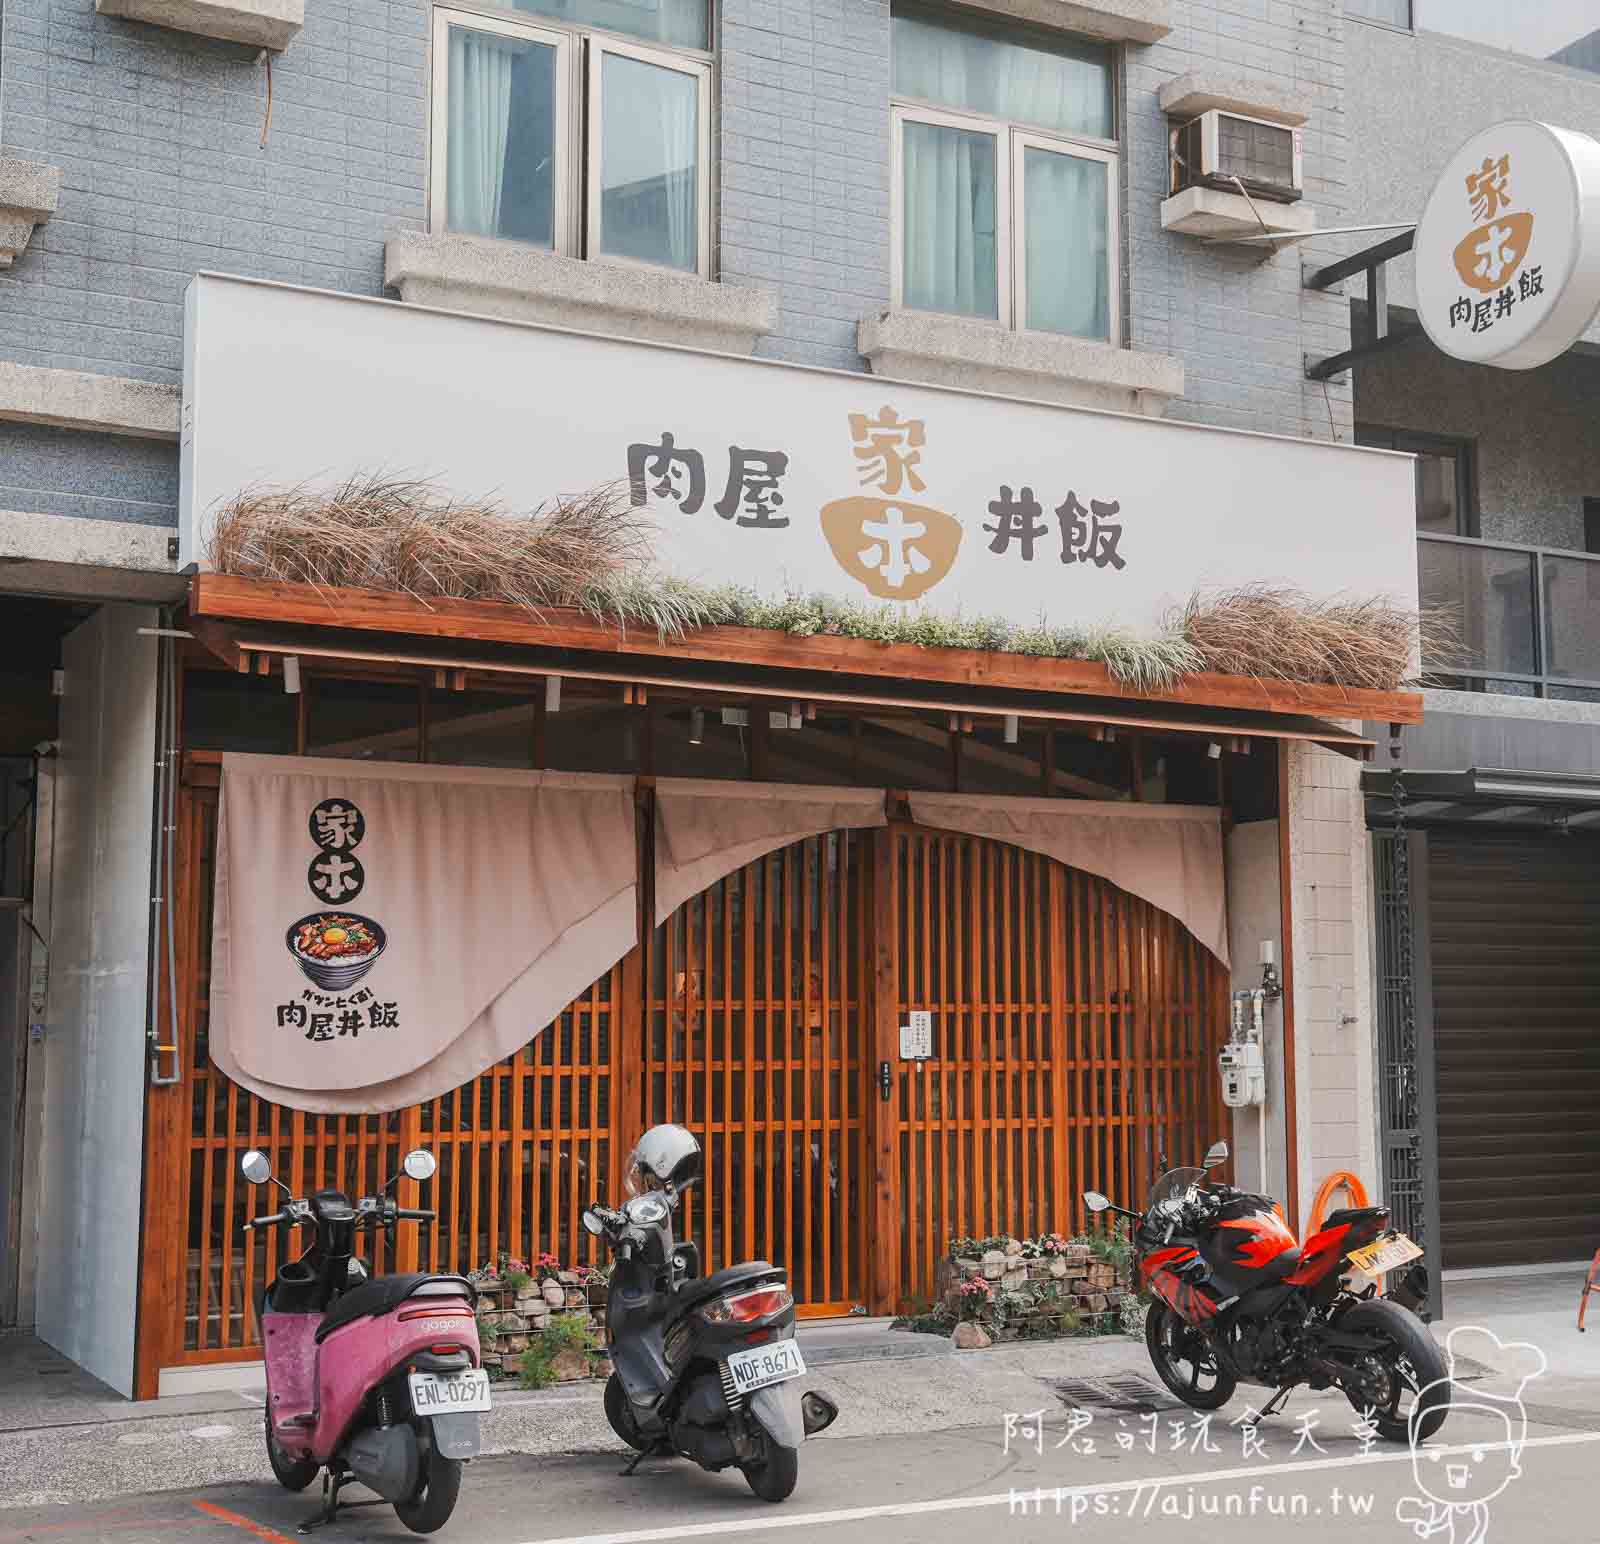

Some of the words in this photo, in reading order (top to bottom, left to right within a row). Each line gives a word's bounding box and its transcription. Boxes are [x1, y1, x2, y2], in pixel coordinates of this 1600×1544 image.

[1449, 265, 1545, 333] 肉屋丼飯
[626, 431, 790, 529] 肉屋
[982, 485, 1127, 570] 丼飯
[276, 1000, 400, 1042] 肉屋丼飯
[733, 1349, 799, 1385] NDF-8671
[414, 1380, 488, 1406] ENL-0297
